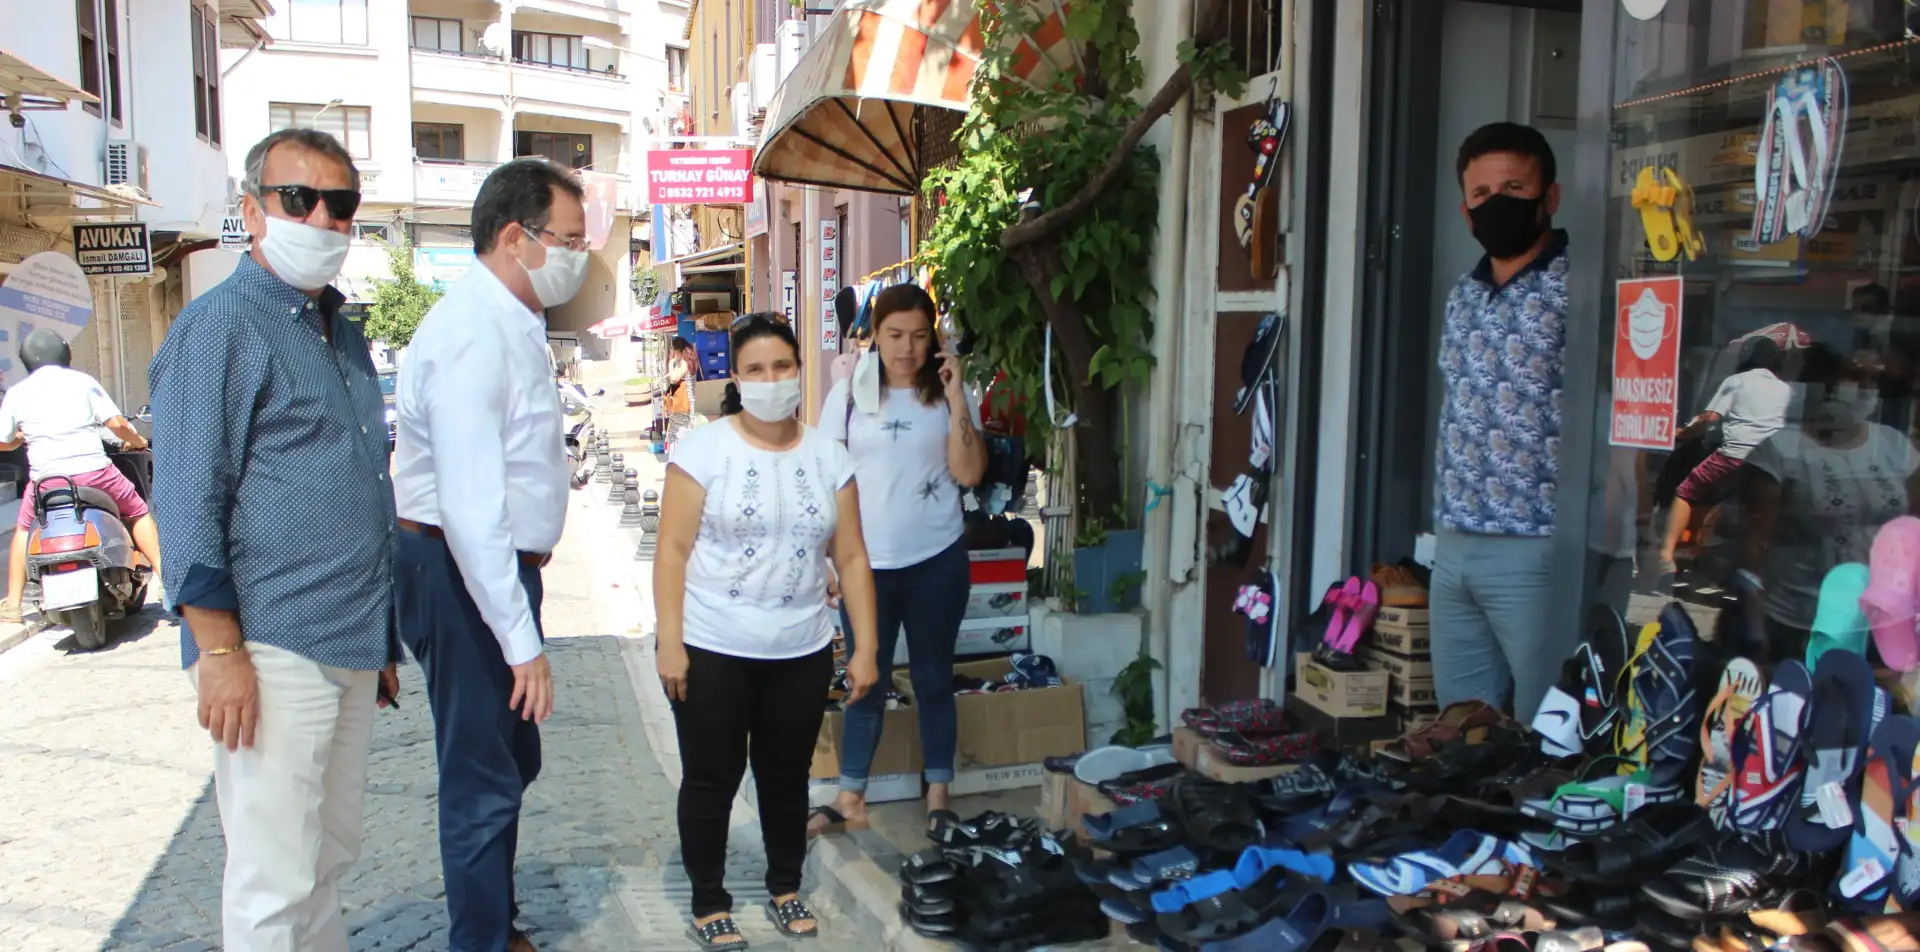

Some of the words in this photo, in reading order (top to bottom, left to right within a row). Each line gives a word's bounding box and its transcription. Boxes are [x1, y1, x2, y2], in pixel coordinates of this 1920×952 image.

[706, 167, 750, 183] GÜNAY
[695, 187, 714, 198] 721
[717, 187, 743, 198] 4913
[222, 218, 246, 232] AVU
[80, 227, 142, 249] AVUKAT
[823, 226, 836, 343] BERBER
[1615, 372, 1674, 405] MASKESİZ
[1614, 409, 1670, 443] GİRİLMEZ
[985, 770, 1010, 782] NEW
